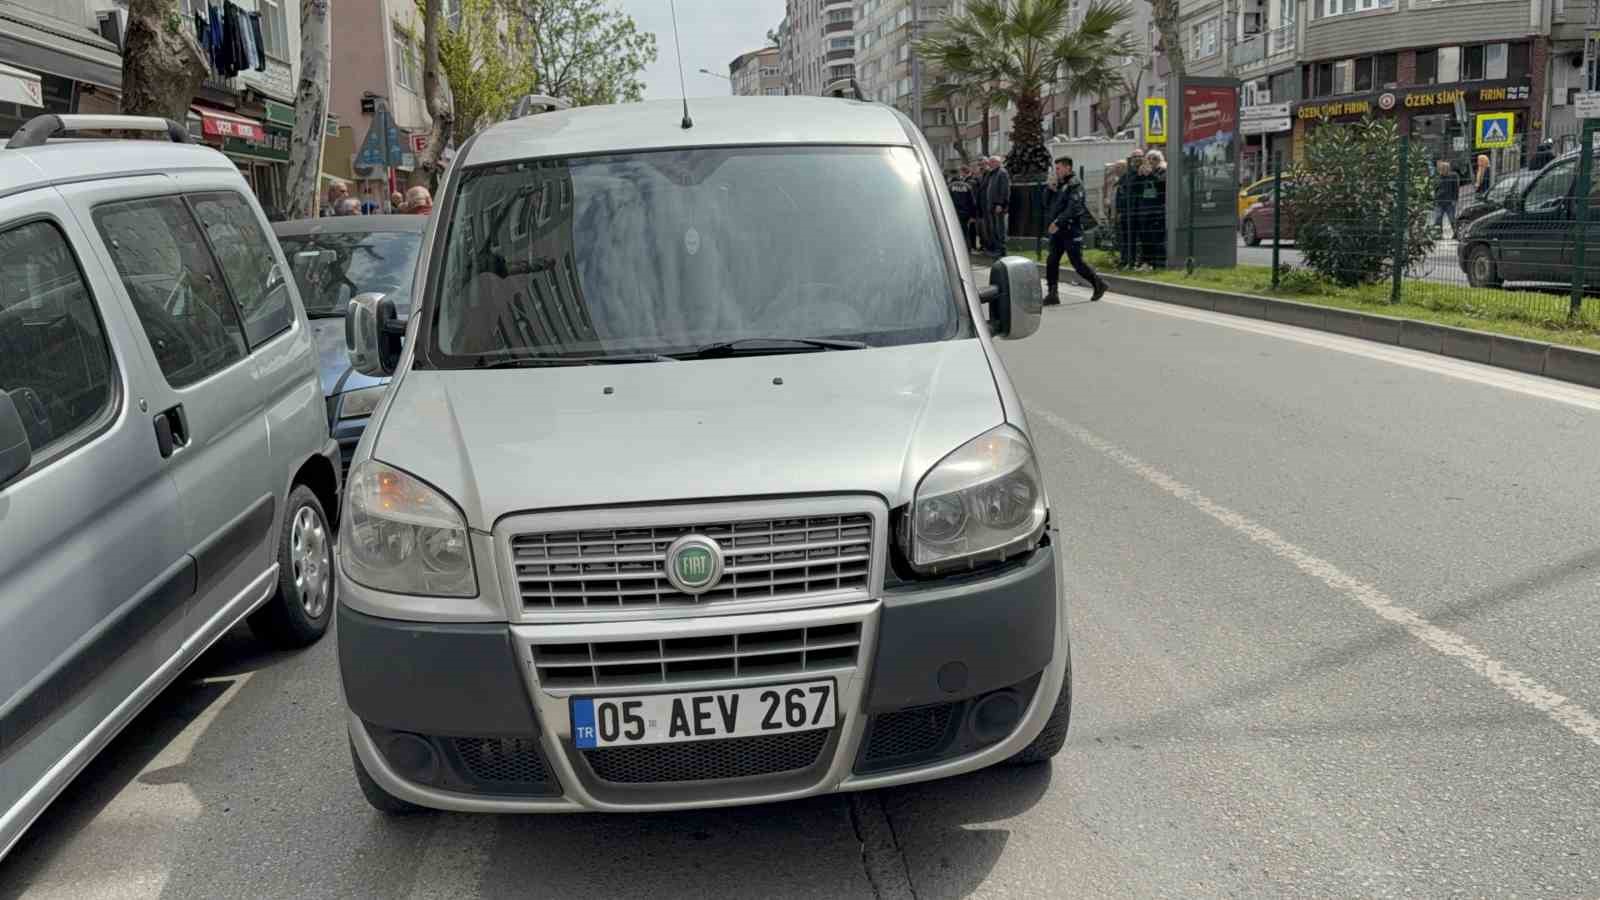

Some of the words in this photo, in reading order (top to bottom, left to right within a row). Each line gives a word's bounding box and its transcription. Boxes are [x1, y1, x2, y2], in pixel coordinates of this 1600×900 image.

[1405, 93, 1434, 107] ÖZEN
[1479, 88, 1505, 101] FIRINI
[1298, 105, 1321, 119] ÖZEN
[683, 555, 706, 577] FIAT
[598, 701, 645, 742] 05
[669, 694, 739, 738] AEV
[760, 685, 830, 731] 267
[576, 727, 594, 739] TR
